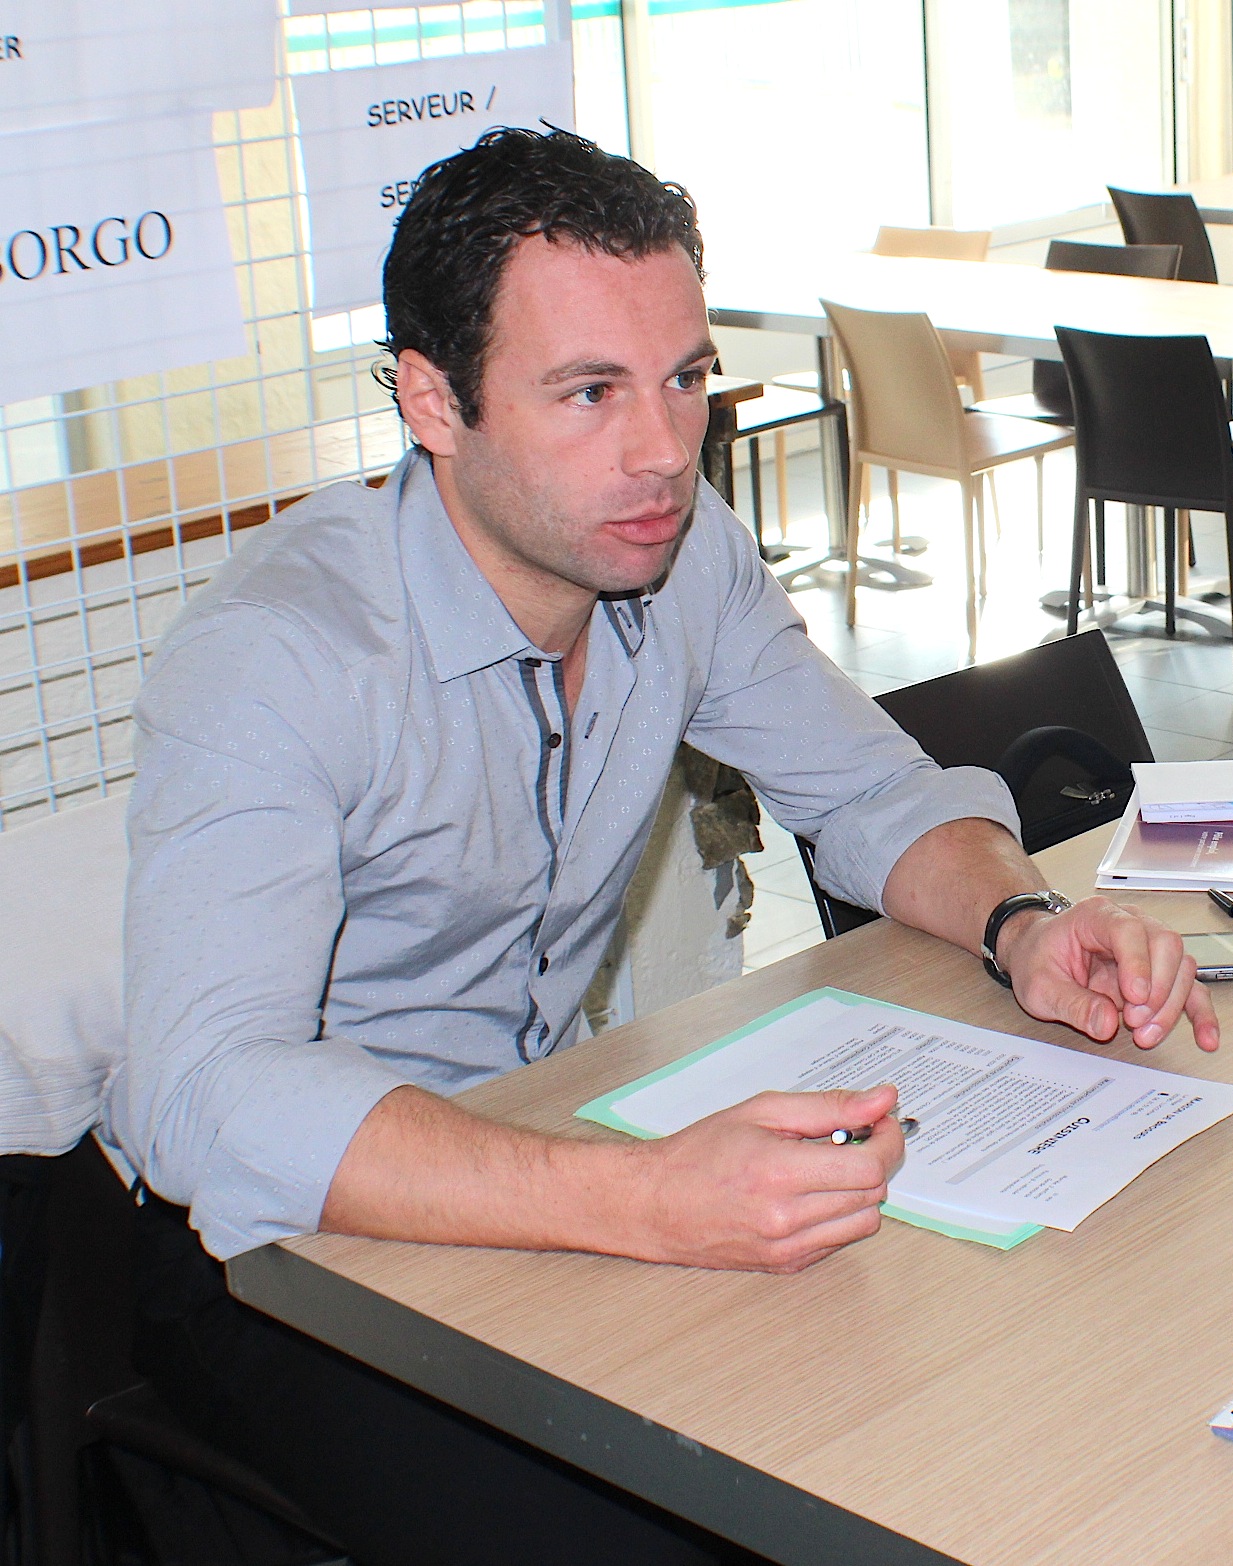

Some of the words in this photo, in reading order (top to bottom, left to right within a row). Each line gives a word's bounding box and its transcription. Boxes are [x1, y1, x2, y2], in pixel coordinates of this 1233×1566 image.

[0, 36, 23, 60] R
[367, 91, 475, 127] SERVEUR
[0, 211, 172, 281] ORGO
